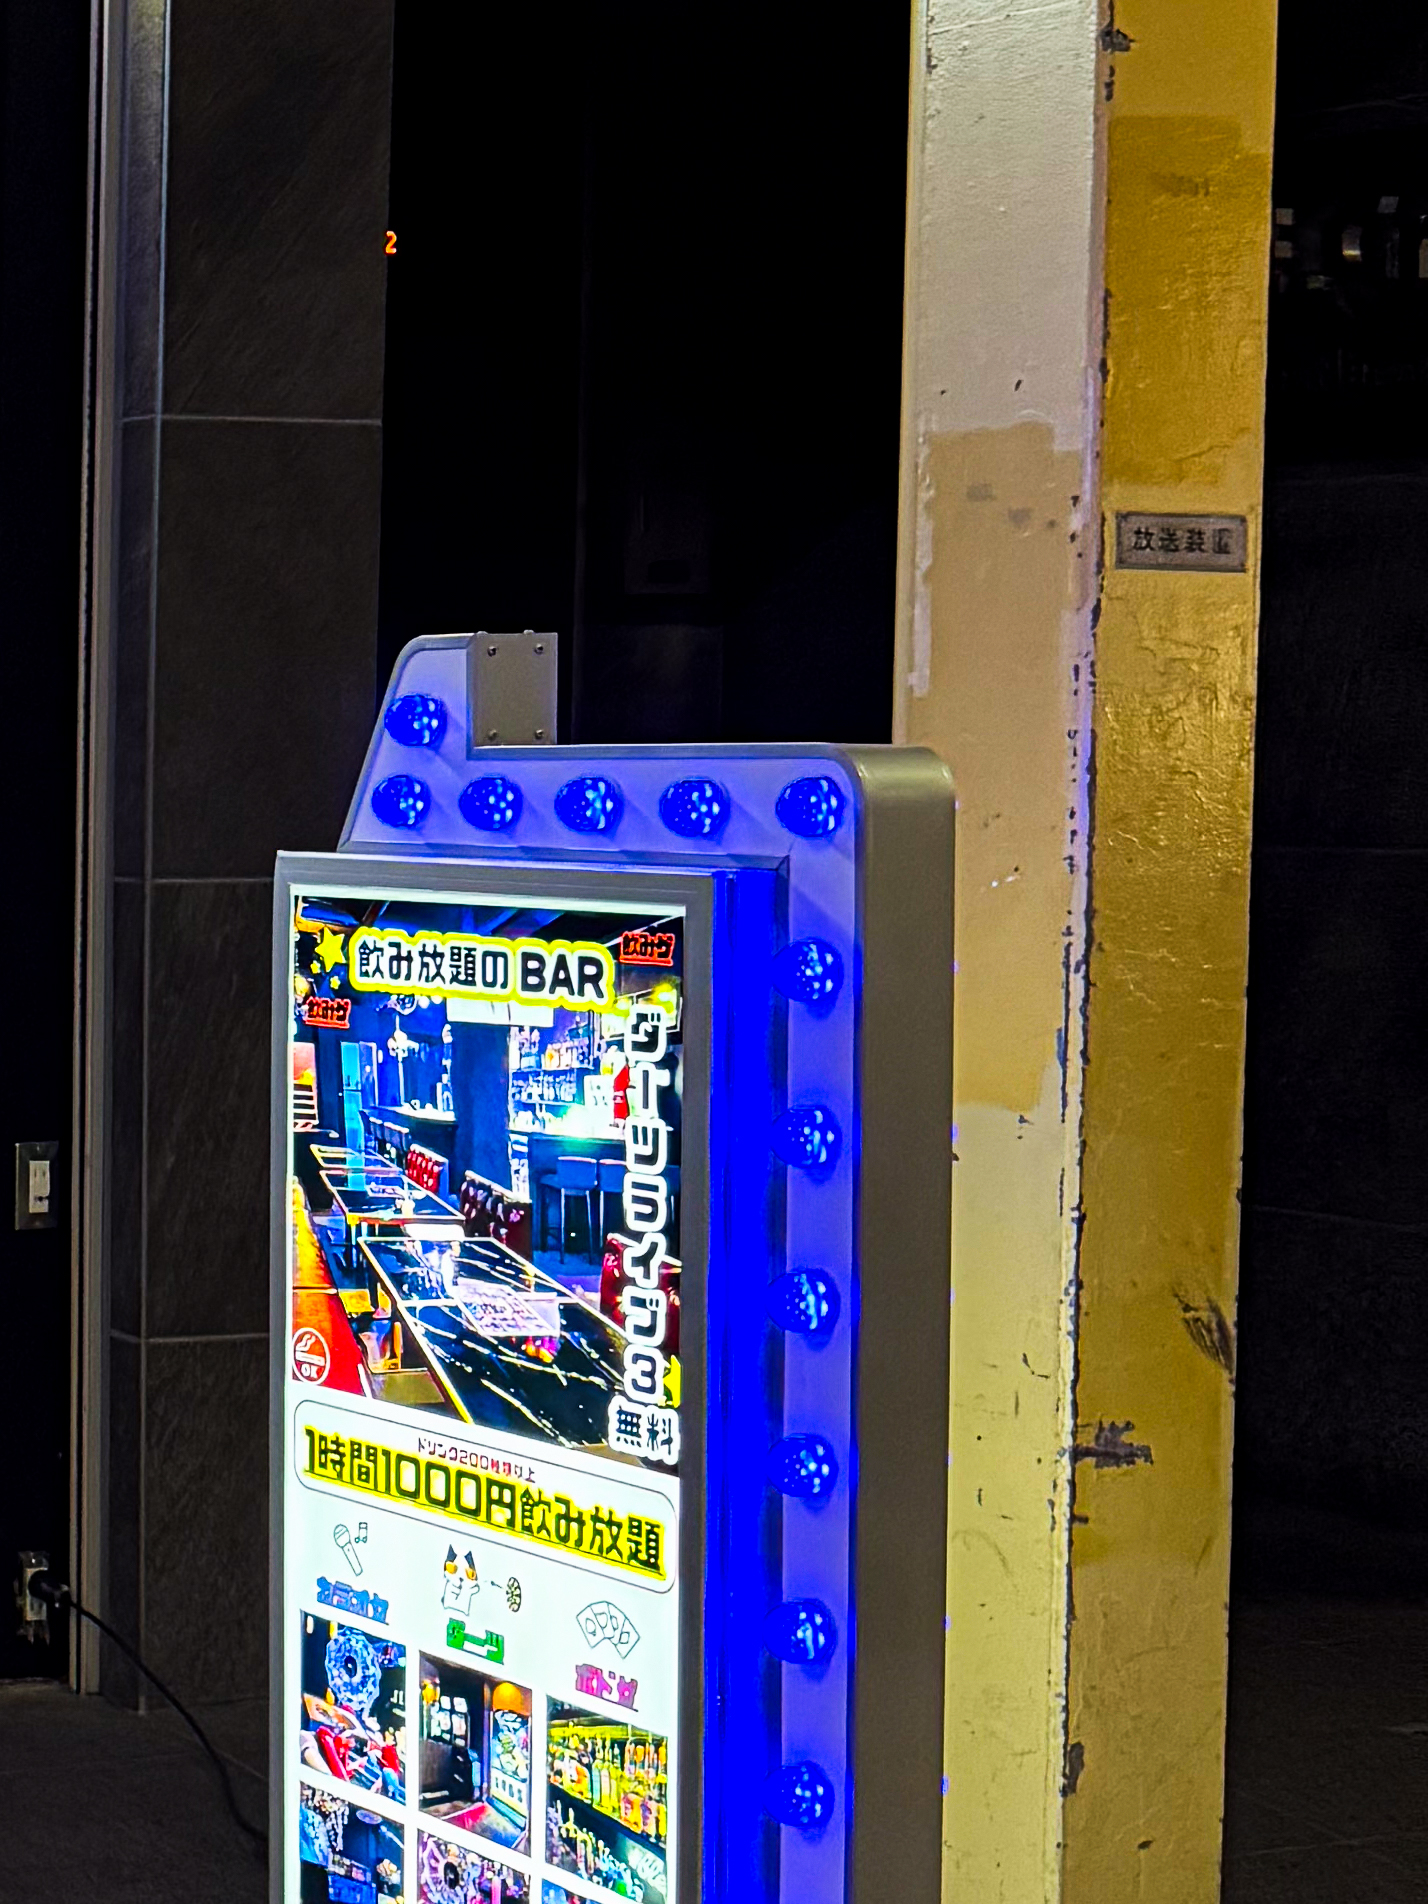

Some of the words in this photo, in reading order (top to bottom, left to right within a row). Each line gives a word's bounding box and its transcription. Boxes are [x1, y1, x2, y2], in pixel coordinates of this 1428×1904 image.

[385, 229, 397, 254] 2
[519, 950, 605, 1001] BAR
[300, 1363, 319, 1379] OK
[304, 1427, 666, 1574] 1時間1000円飲み放題
